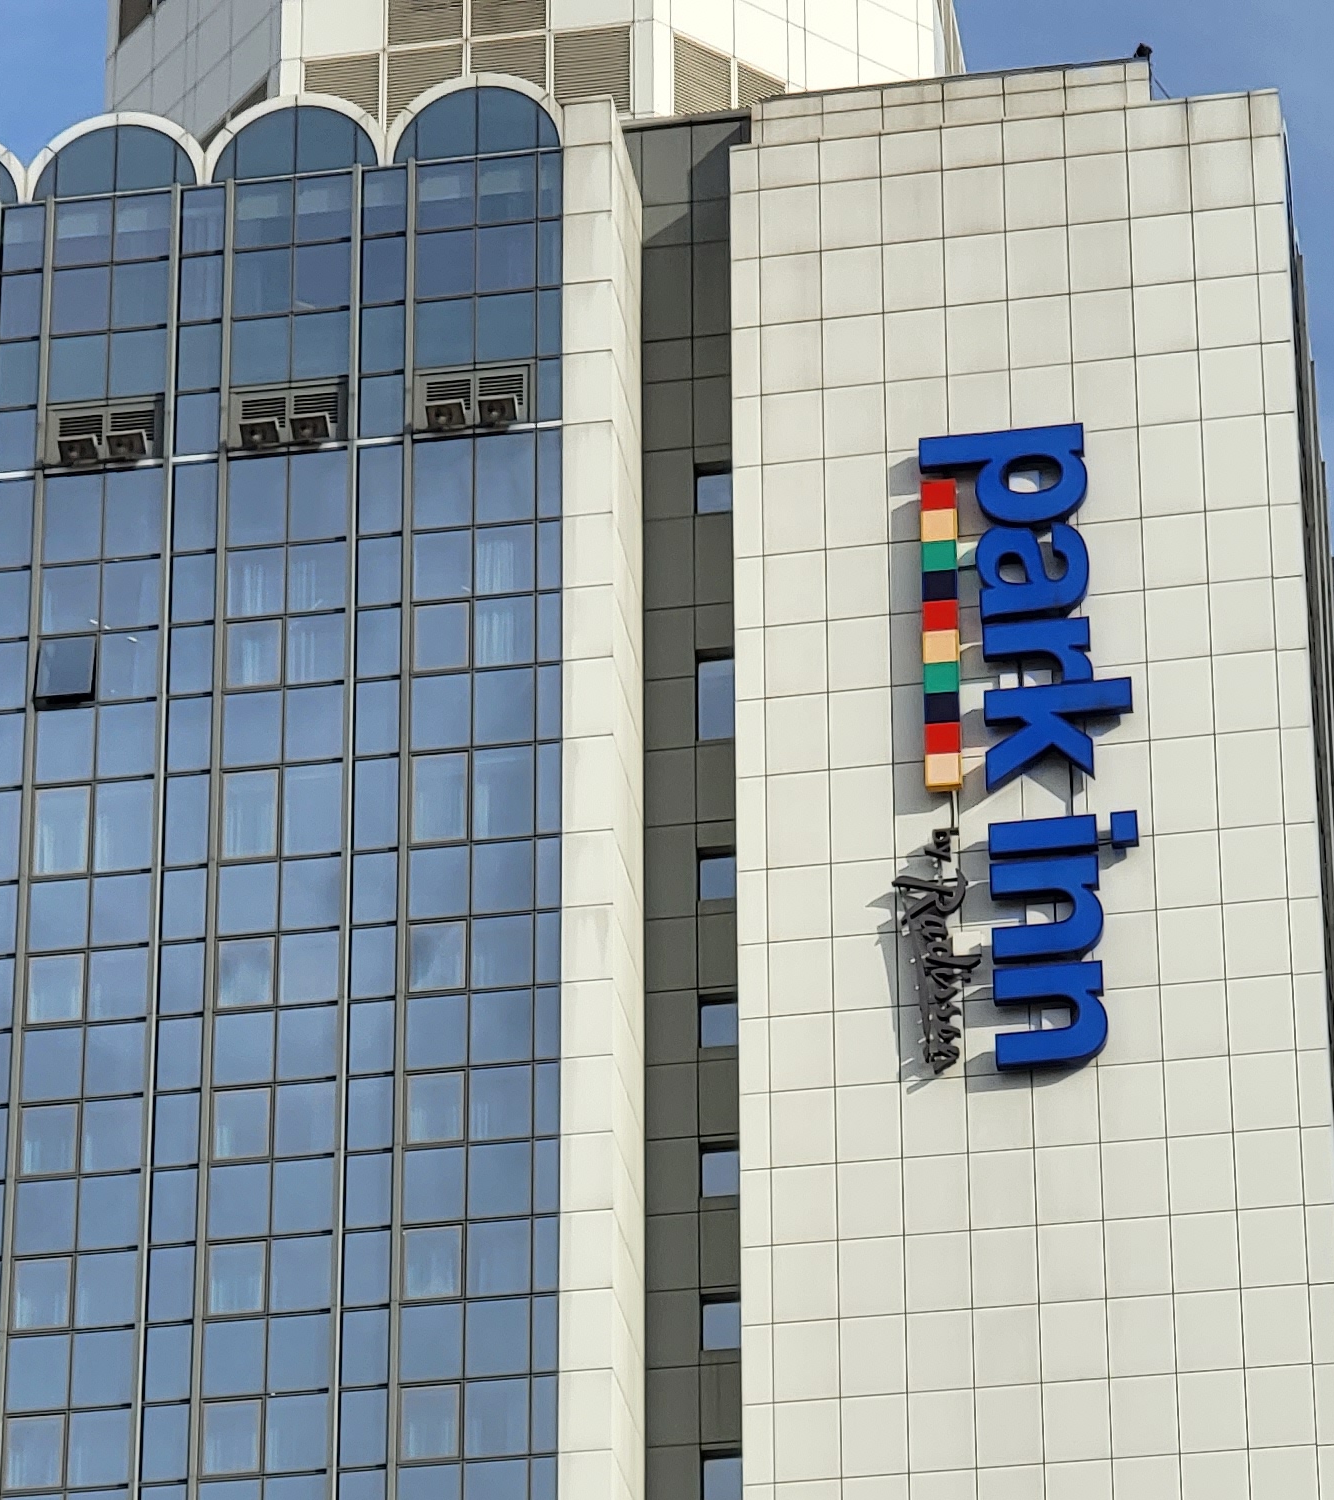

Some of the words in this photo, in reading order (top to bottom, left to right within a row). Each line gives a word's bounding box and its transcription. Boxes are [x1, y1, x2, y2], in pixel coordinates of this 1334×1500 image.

[919, 423, 1132, 790] park
[925, 827, 960, 863] by
[987, 810, 1139, 1071] inn
[893, 869, 982, 1074] Radisson
